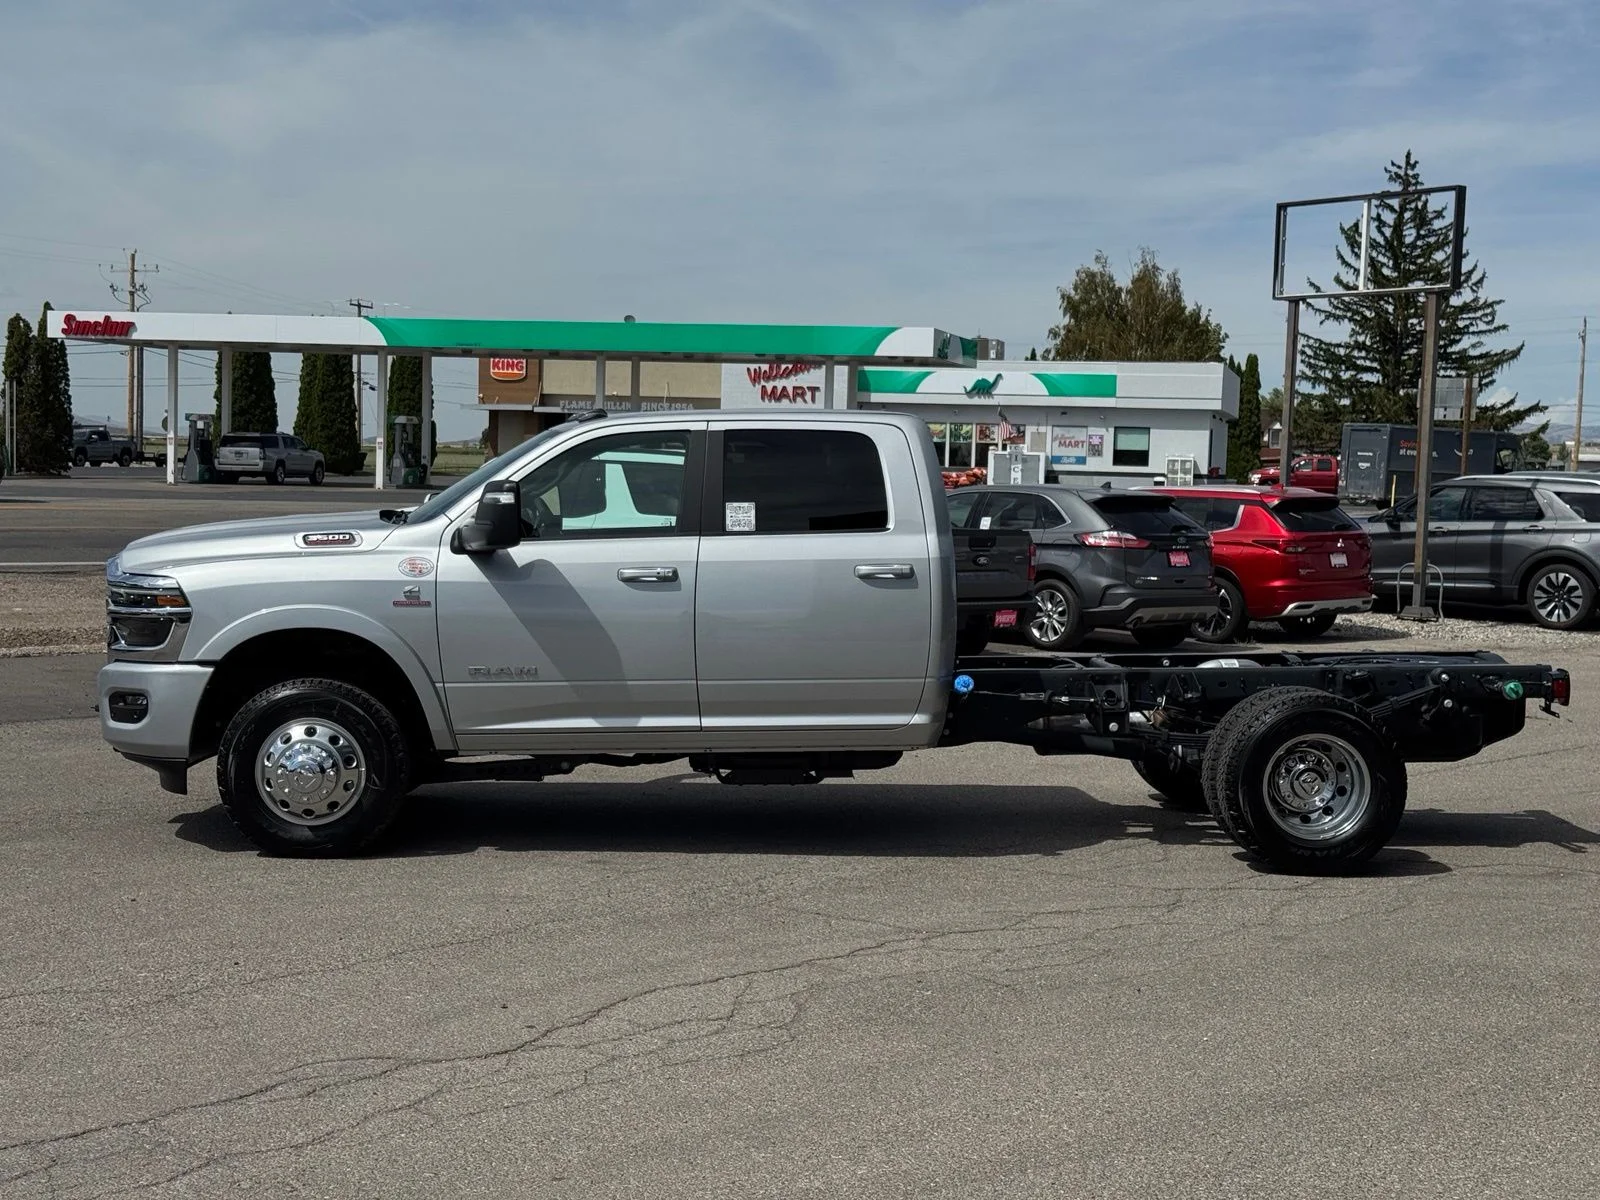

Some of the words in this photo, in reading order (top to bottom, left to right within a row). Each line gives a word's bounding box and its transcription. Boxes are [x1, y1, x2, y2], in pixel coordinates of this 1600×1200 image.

[61, 313, 136, 337] Sinclair
[491, 359, 525, 371] KING
[760, 385, 821, 404] MART
[1058, 440, 1086, 449] MART
[468, 665, 538, 677] RAM
